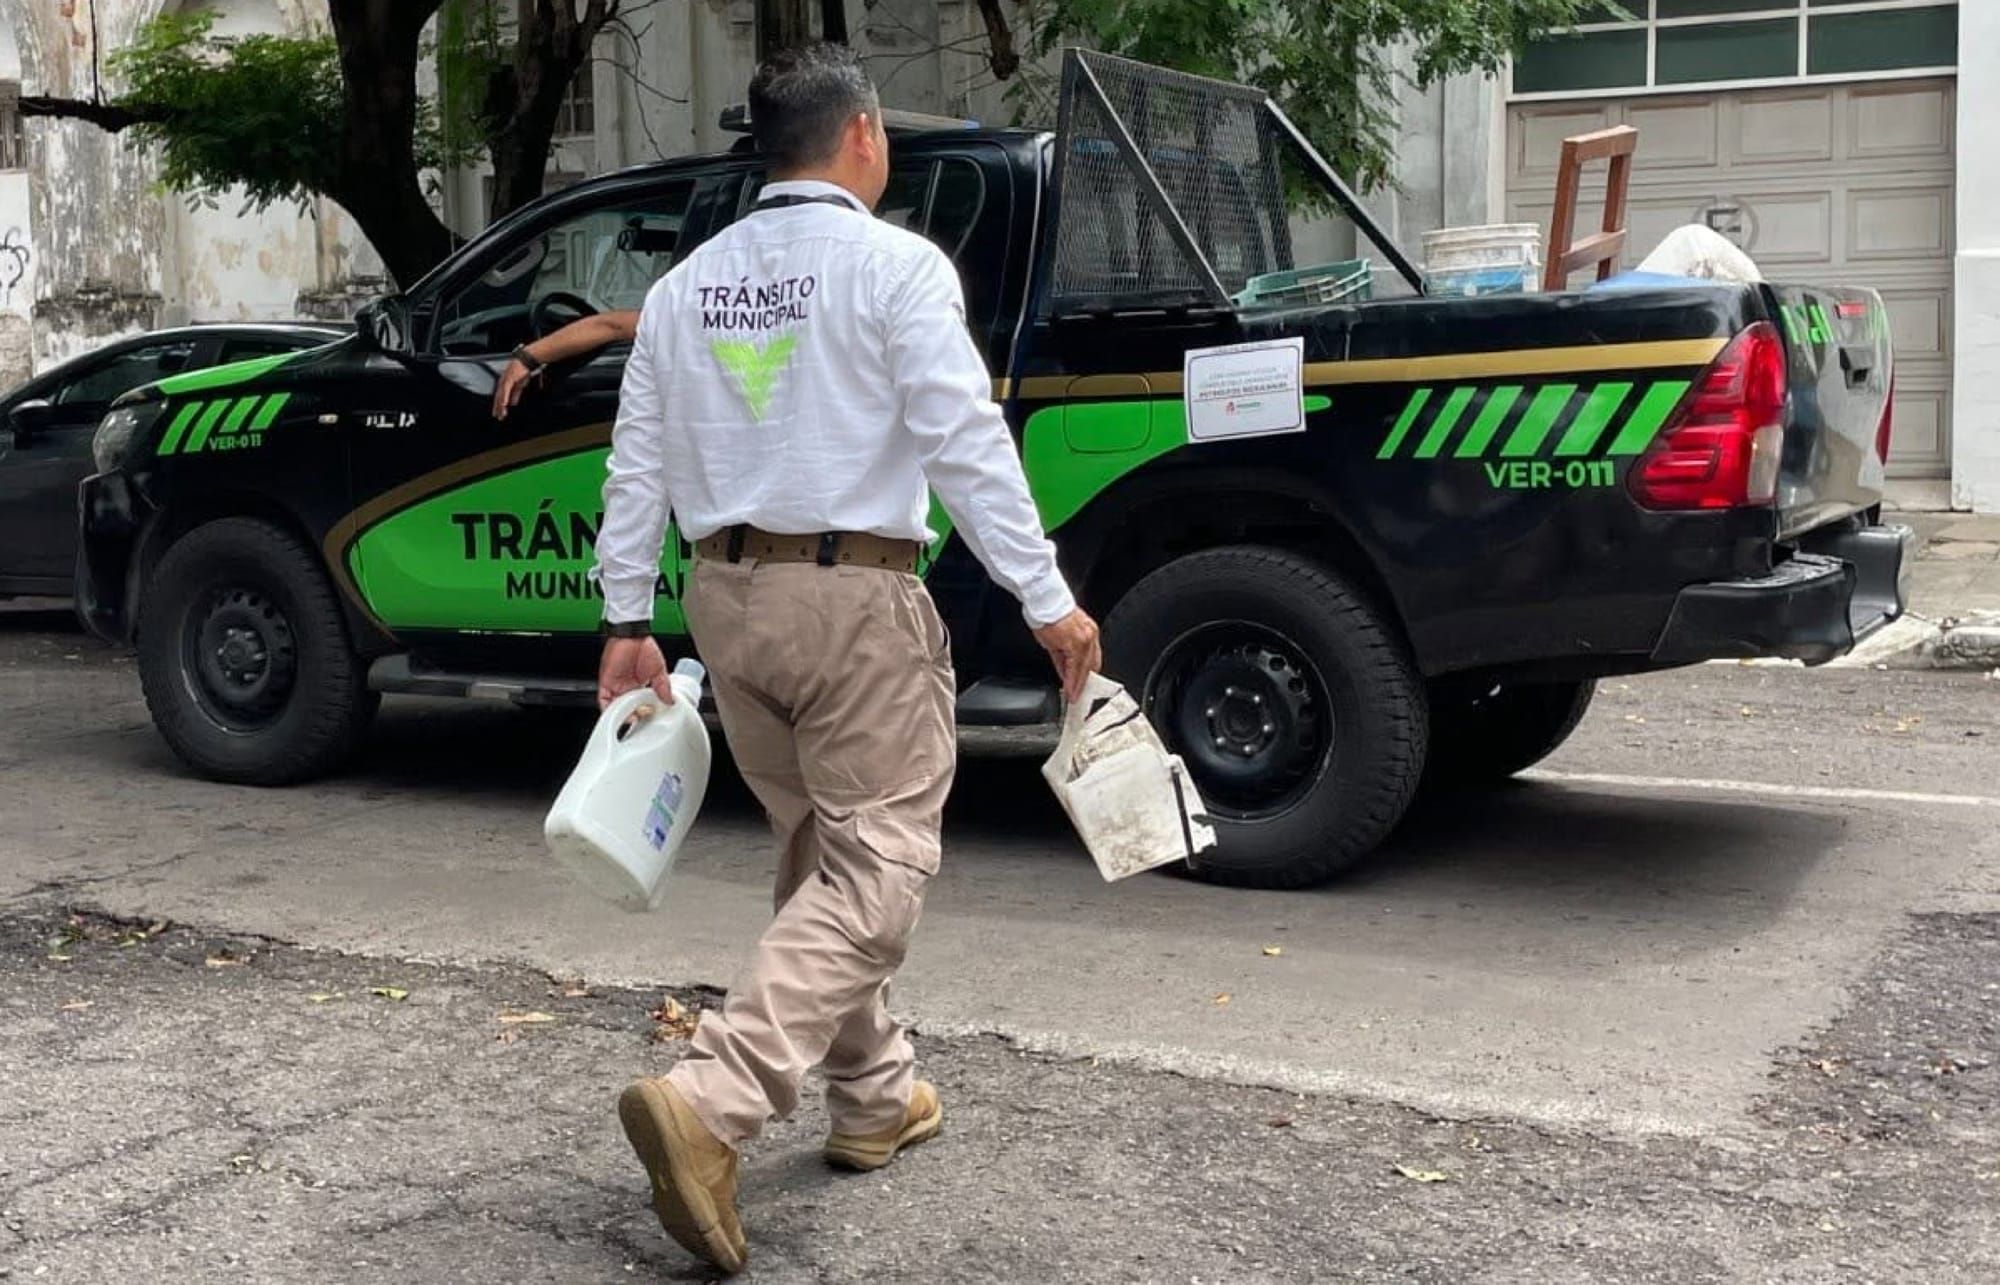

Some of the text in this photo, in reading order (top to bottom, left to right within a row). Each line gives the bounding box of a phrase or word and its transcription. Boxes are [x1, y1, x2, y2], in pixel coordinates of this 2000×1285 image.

[699, 275, 815, 309] TRÁNSITO
[703, 302, 808, 331] MUNICIPAL
[209, 434, 262, 450] VER-011
[1484, 460, 1616, 488] VER-011
[452, 499, 692, 560] TRÁN
